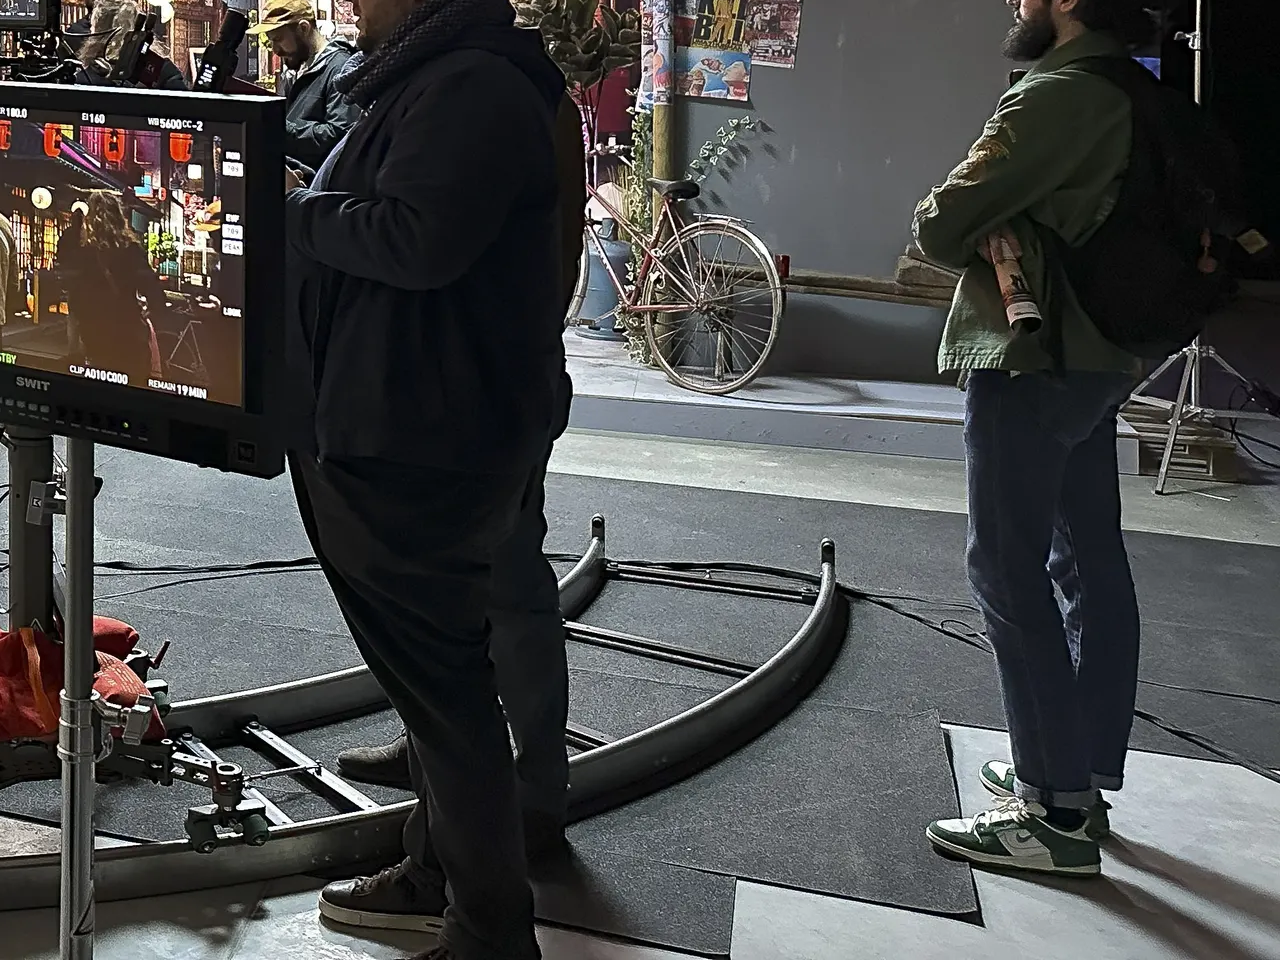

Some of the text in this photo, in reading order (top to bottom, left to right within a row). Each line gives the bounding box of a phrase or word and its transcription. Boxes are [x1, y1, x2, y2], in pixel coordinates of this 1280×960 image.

[89, 113, 105, 124] 160
[159, 118, 182, 130] 5600
[69, 365, 84, 374] CLIP
[16, 376, 50, 391] SWIT
[148, 378, 176, 392] REMAIN
